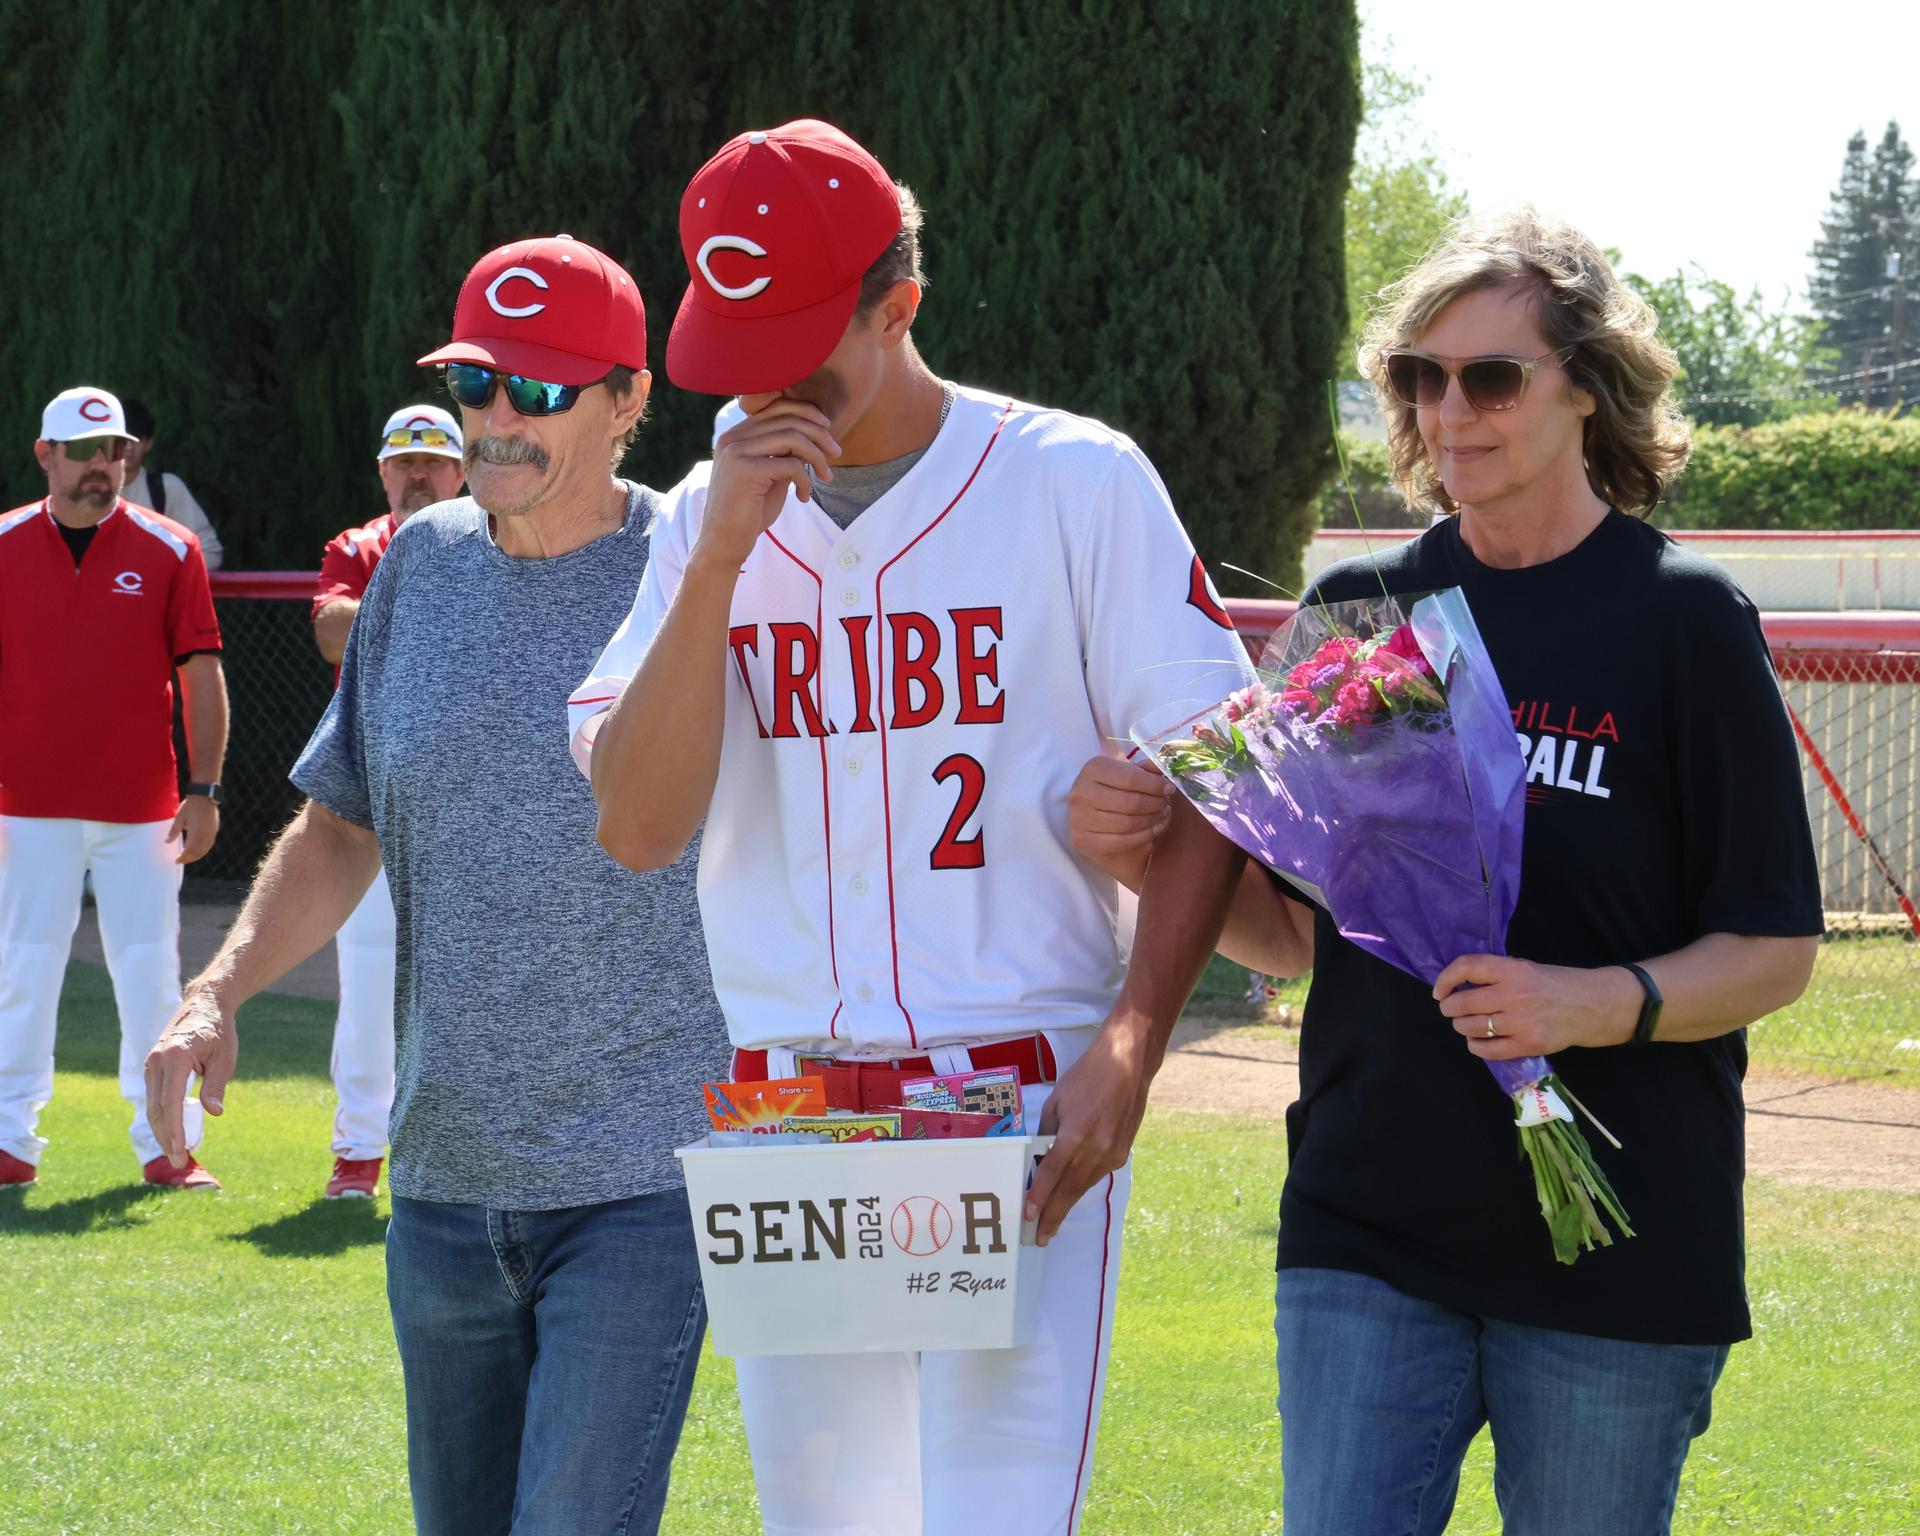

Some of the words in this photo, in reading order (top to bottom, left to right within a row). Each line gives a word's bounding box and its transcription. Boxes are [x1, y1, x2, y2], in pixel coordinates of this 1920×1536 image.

[695, 235, 772, 300] C
[485, 266, 549, 319] C
[78, 397, 112, 422] C
[114, 571, 143, 590] C
[729, 606, 1006, 739] TRIBE
[930, 753, 986, 870] 2
[778, 1087, 801, 1095] Share
[914, 1090, 950, 1101] CROSSWORD
[926, 1096, 957, 1106] EXPRESS
[857, 1196, 885, 1260] 2024
[906, 1272, 941, 1295] #2
[950, 1270, 1008, 1298] Ryan
